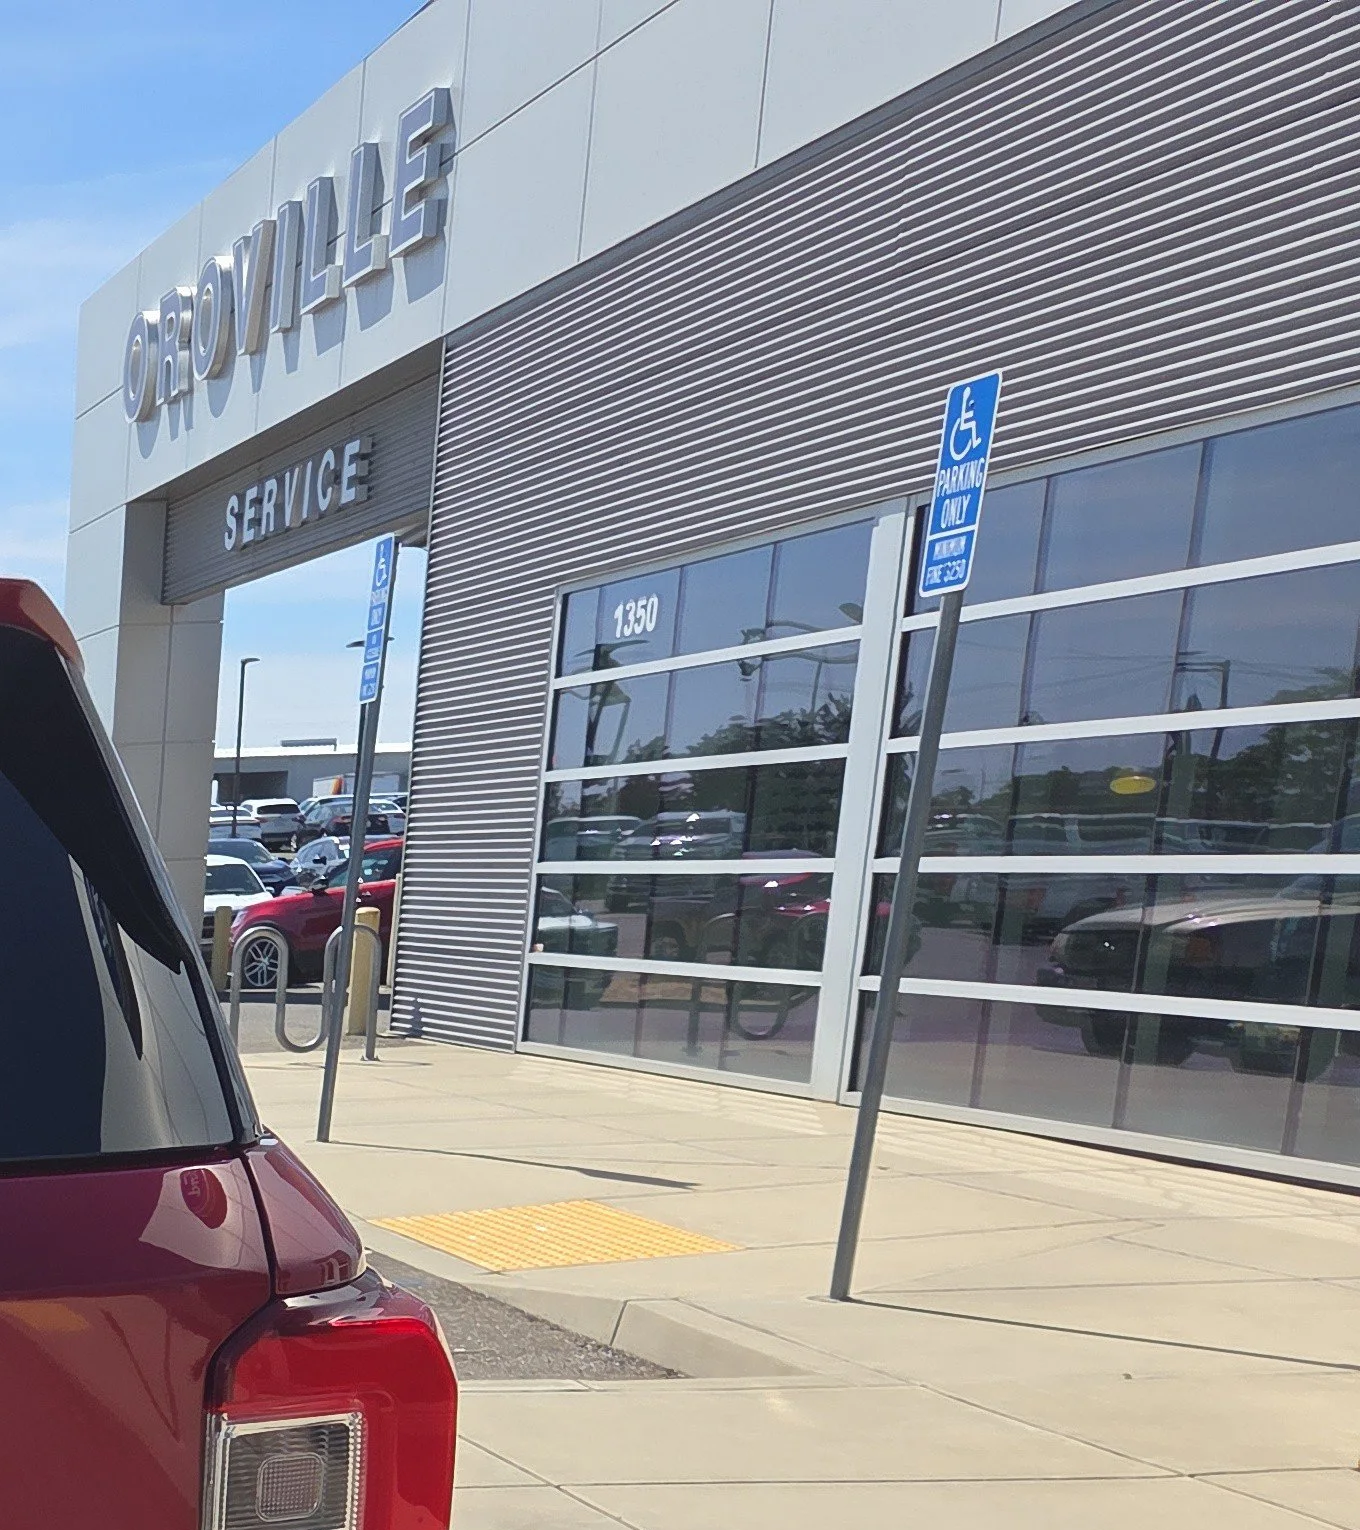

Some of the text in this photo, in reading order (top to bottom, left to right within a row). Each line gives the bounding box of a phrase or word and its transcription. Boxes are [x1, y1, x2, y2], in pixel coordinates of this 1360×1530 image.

[123, 87, 453, 424] OROVILLE
[223, 438, 363, 552] SERVICE
[936, 457, 985, 498] PARKING
[940, 493, 971, 529] ONLY
[612, 593, 659, 638] 1350
